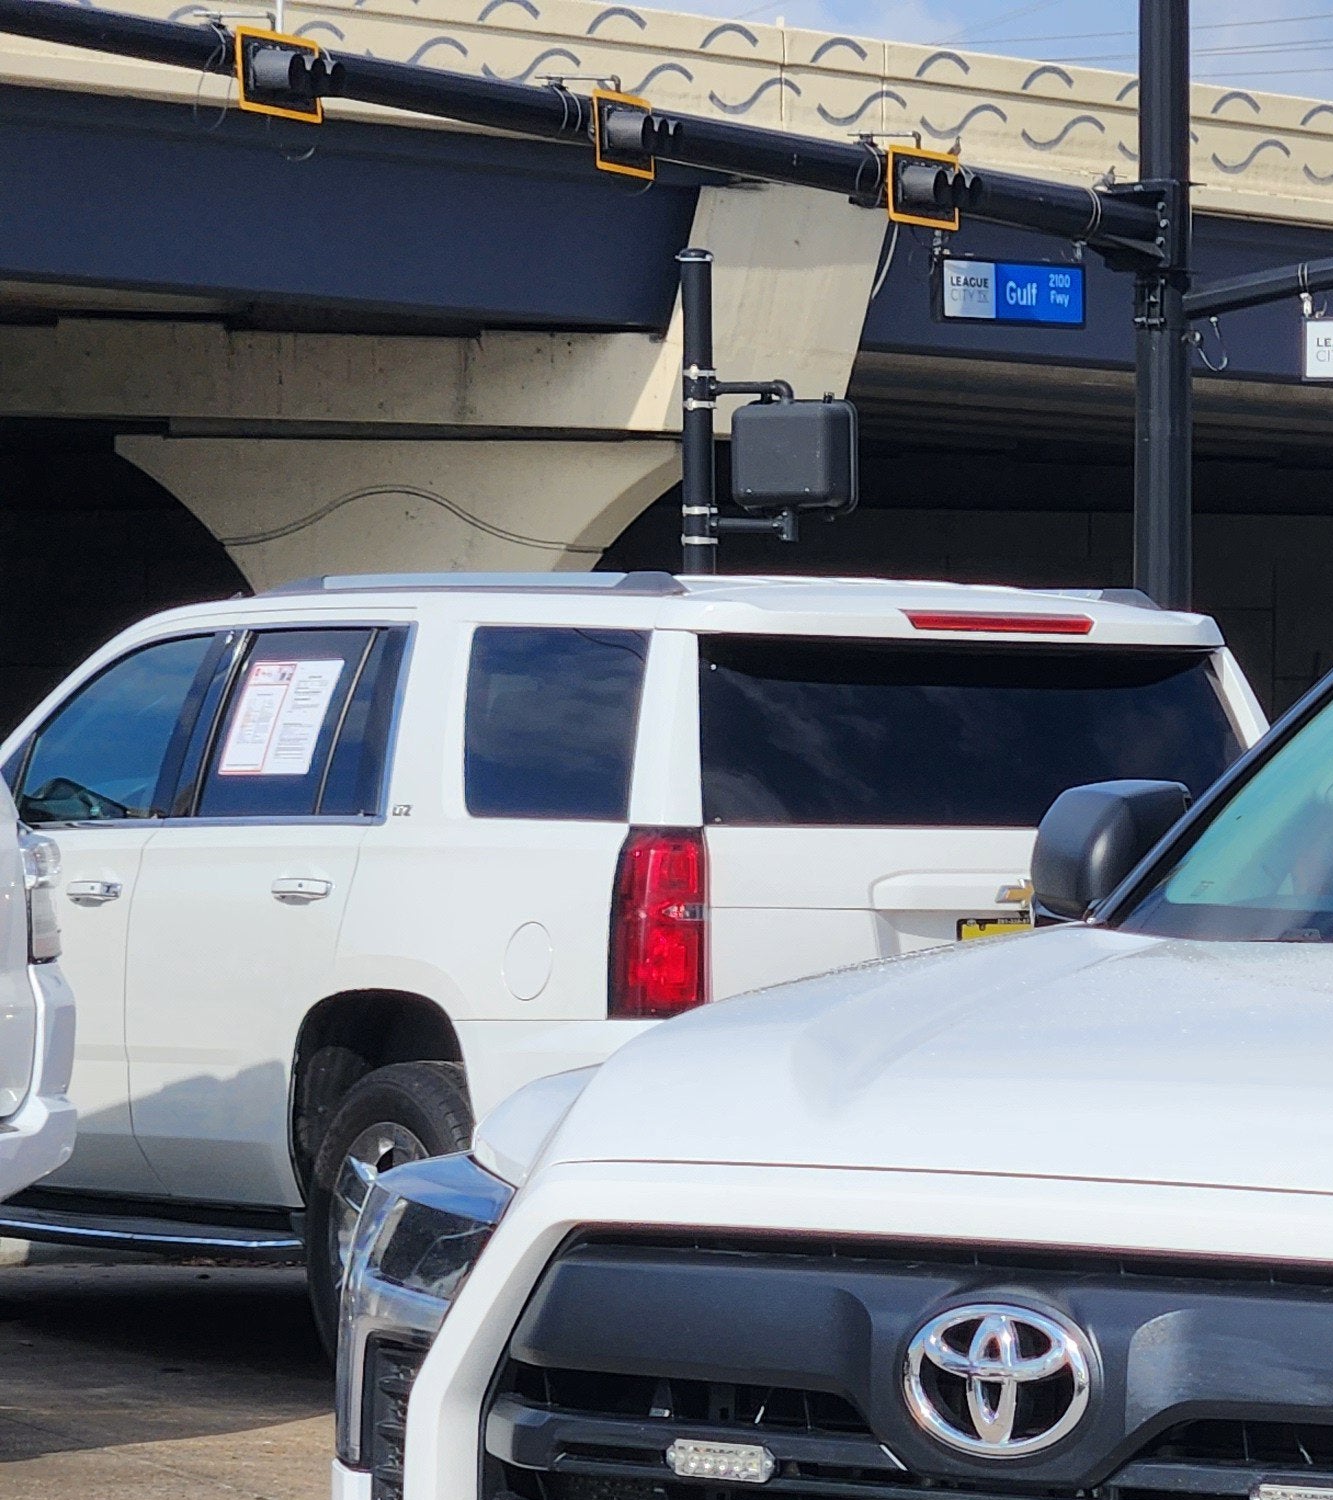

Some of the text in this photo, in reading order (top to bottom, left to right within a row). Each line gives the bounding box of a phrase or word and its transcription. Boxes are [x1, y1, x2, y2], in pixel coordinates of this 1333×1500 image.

[950, 276, 989, 288] LEAGUE
[1049, 273, 1071, 288] 2100
[950, 289, 974, 302] CITY
[1006, 281, 1038, 306] Gulf
[1050, 290, 1070, 307] Fwy
